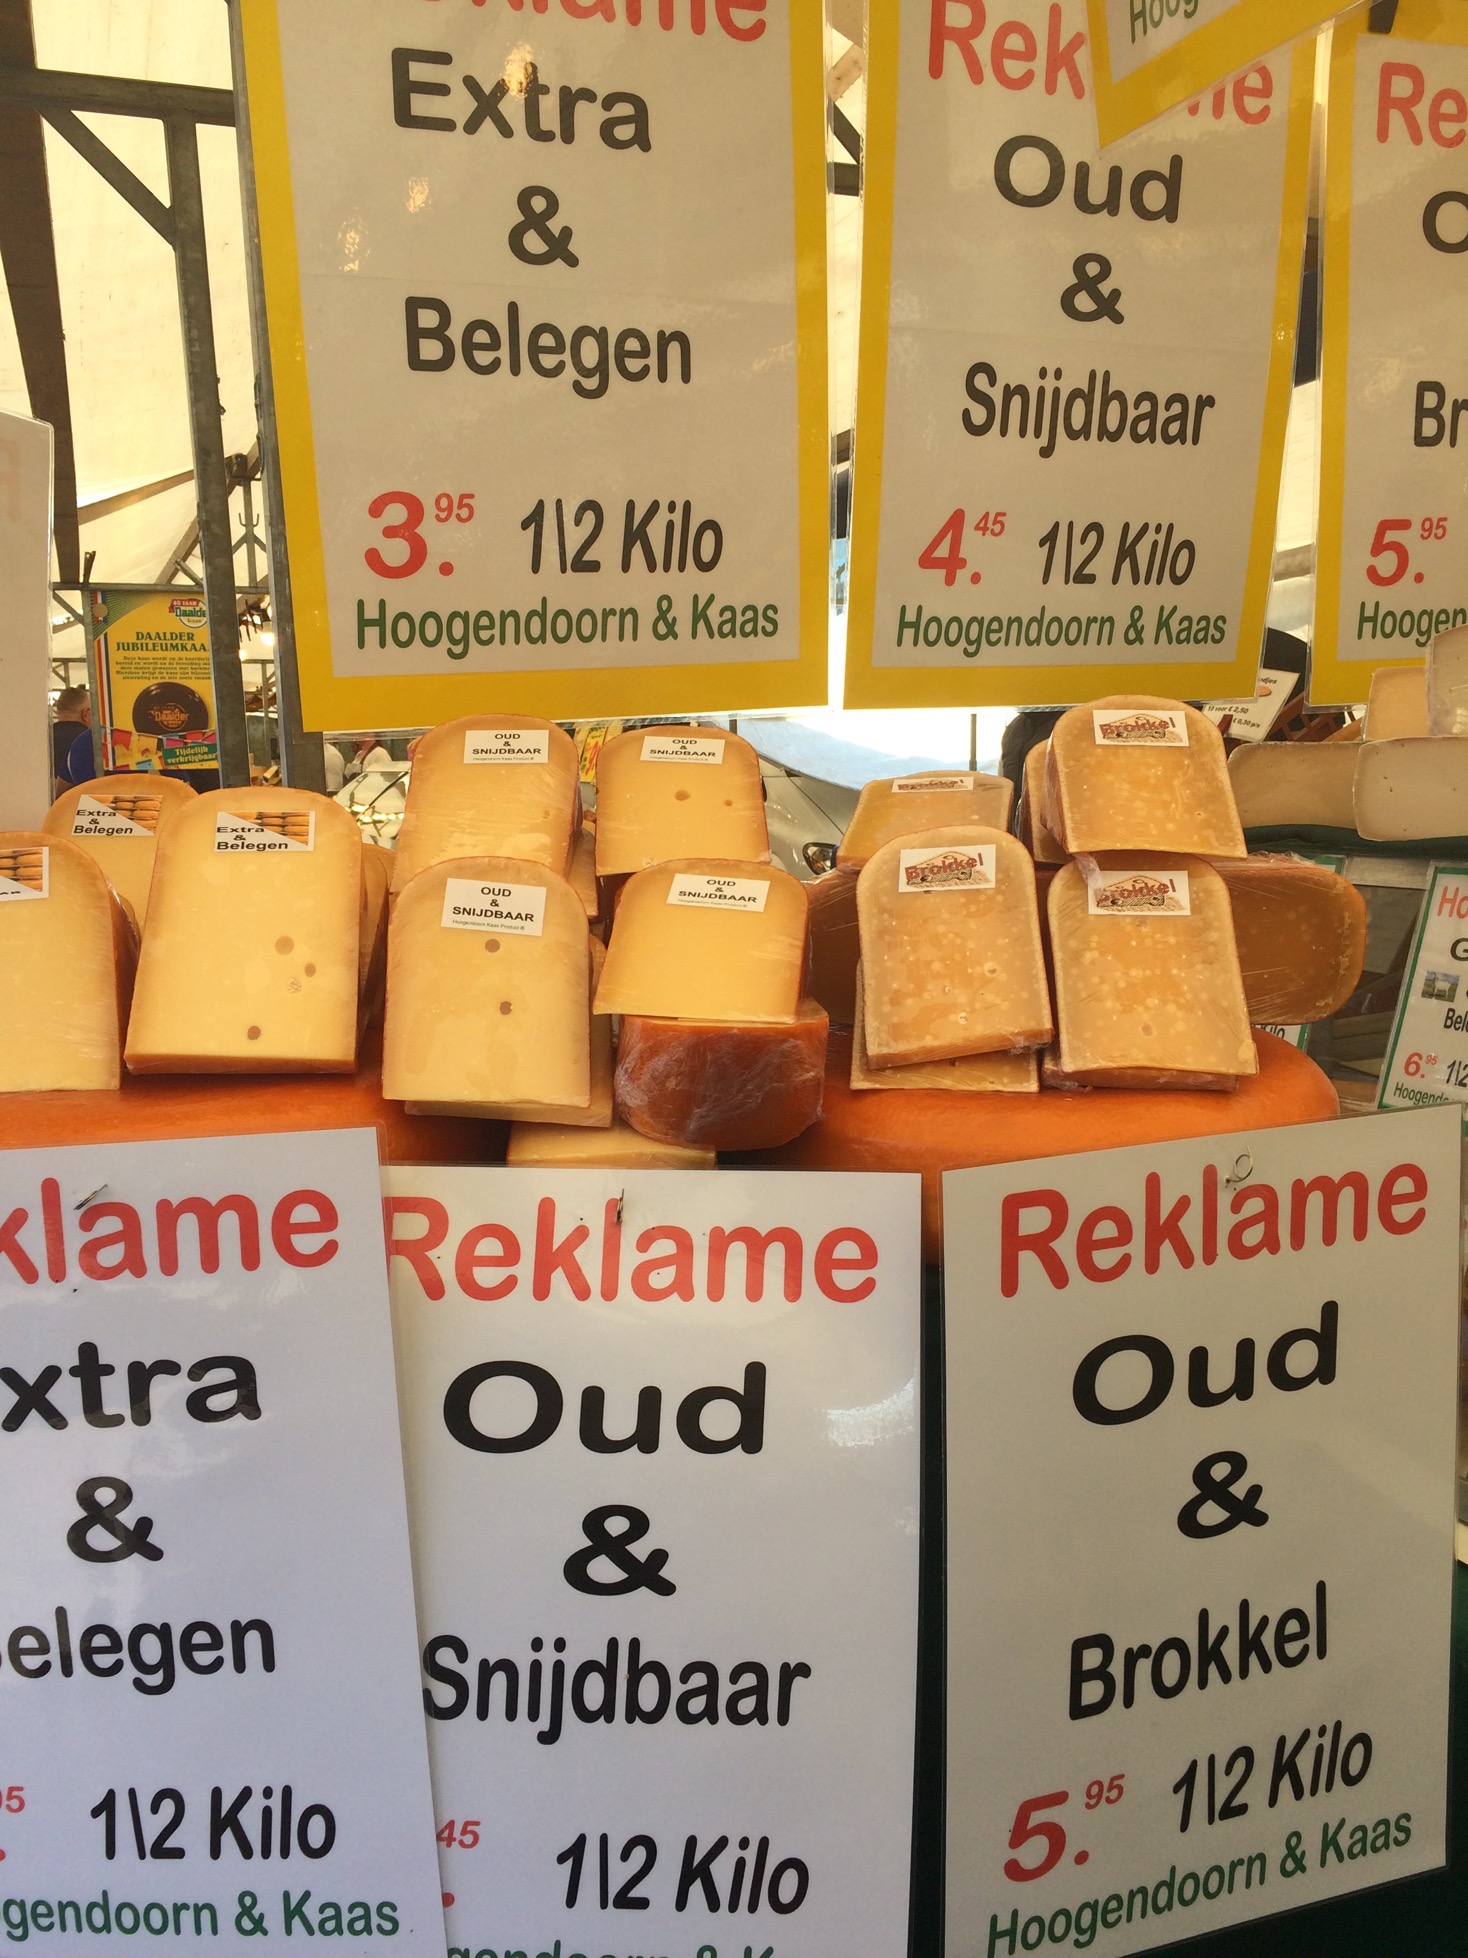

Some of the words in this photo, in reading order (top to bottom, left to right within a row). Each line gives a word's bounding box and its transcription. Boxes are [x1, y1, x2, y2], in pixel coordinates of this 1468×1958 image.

[391, 47, 652, 152] Extra
[1377, 62, 1468, 148] Re
[993, 135, 1183, 223] Oud
[508, 185, 579, 268] &
[1060, 253, 1125, 324] &
[404, 296, 691, 399] Belegen
[962, 362, 1216, 458] Snijdbaar
[1413, 381, 1468, 449] Br
[621, 499, 724, 574] Kilo
[1111, 522, 1196, 586] Kilo
[116, 642, 210, 652] JUBILEUMKAA
[136, 631, 195, 642] DAALDER
[357, 598, 639, 660] Hoogendoorn
[652, 594, 678, 641] &
[691, 593, 779, 640] Kaas
[896, 604, 1115, 658] Hoogendoorn
[1124, 605, 1145, 647] &
[1154, 605, 1228, 646] Kaas
[649, 749, 716, 757] SNIJDBAAR
[1099, 717, 1176, 736] Brokkel
[73, 825, 133, 836] Belegen
[76, 809, 117, 817] Extra
[217, 841, 288, 851] Belegen
[481, 886, 512, 897] OUD
[490, 899, 500, 907] &
[678, 891, 757, 903] SNIJDBAAR
[707, 879, 736, 887] OUD
[904, 852, 984, 880] Brokkel
[452, 906, 535, 922] SNIJDBAAR
[1444, 1008, 1468, 1033] Bel
[383, 1196, 879, 1302] Reklame
[1000, 1162, 1429, 1298] Reklame
[1072, 1300, 1339, 1425] Oud
[443, 1360, 765, 1453] Oud
[66, 1475, 164, 1563] &
[1177, 1450, 1269, 1539] &
[563, 1504, 677, 1596] &
[0, 1606, 275, 1696] elegen
[1068, 1579, 1327, 1721] Brokkel
[422, 1634, 812, 1745] Snijdbaar
[1268, 1720, 1373, 1809] Kilo
[209, 1784, 336, 1861] Kilo
[675, 1834, 809, 1914] Kilo
[987, 1850, 1266, 1958] Hoogendoorn
[1279, 1830, 1307, 1874] &
[1319, 1812, 1412, 1870] Kaas
[235, 1890, 269, 1938] &
[283, 1889, 400, 1938] Kaas
